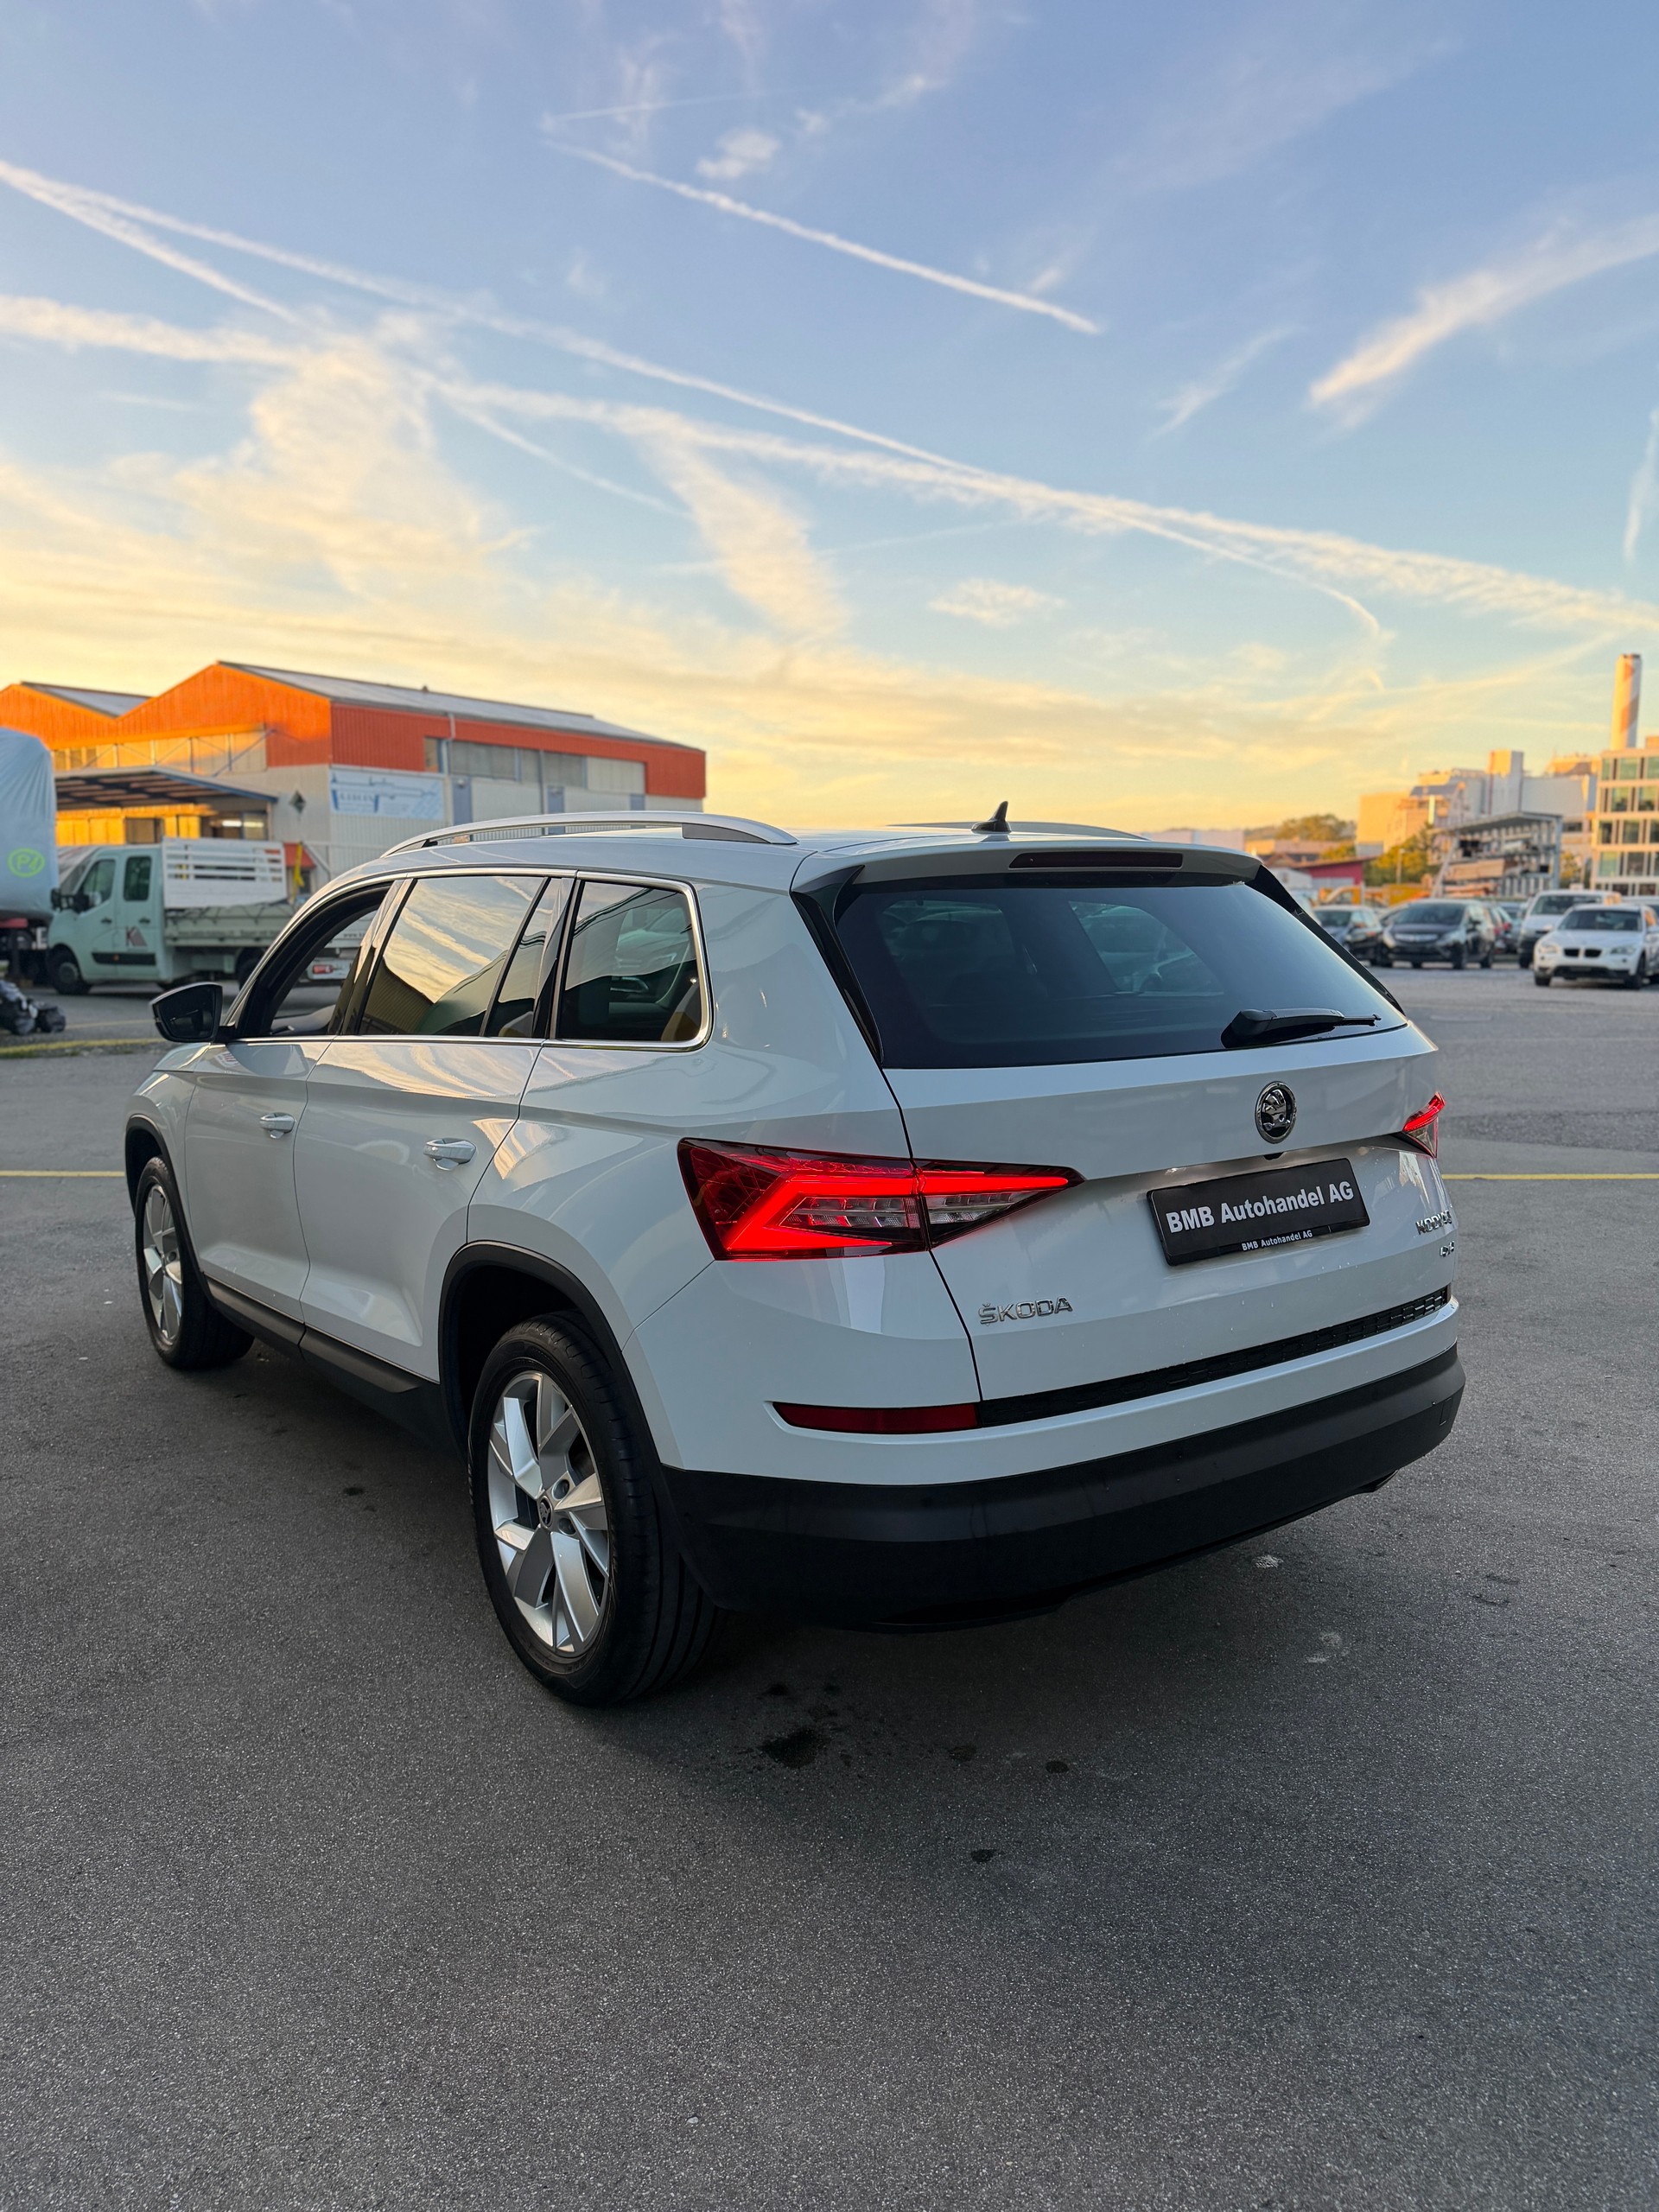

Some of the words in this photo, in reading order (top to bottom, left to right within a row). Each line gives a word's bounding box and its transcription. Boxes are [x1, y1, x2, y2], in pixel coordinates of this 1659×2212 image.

[1166, 1206, 1215, 1234] BMB
[1221, 1186, 1325, 1224] Autohandel
[1328, 1181, 1354, 1203] AG
[1242, 1242, 1259, 1251] BMB
[1261, 1231, 1301, 1248] Autohandel
[1302, 1230, 1313, 1238] AG
[978, 1296, 1073, 1325] ŠKODA
